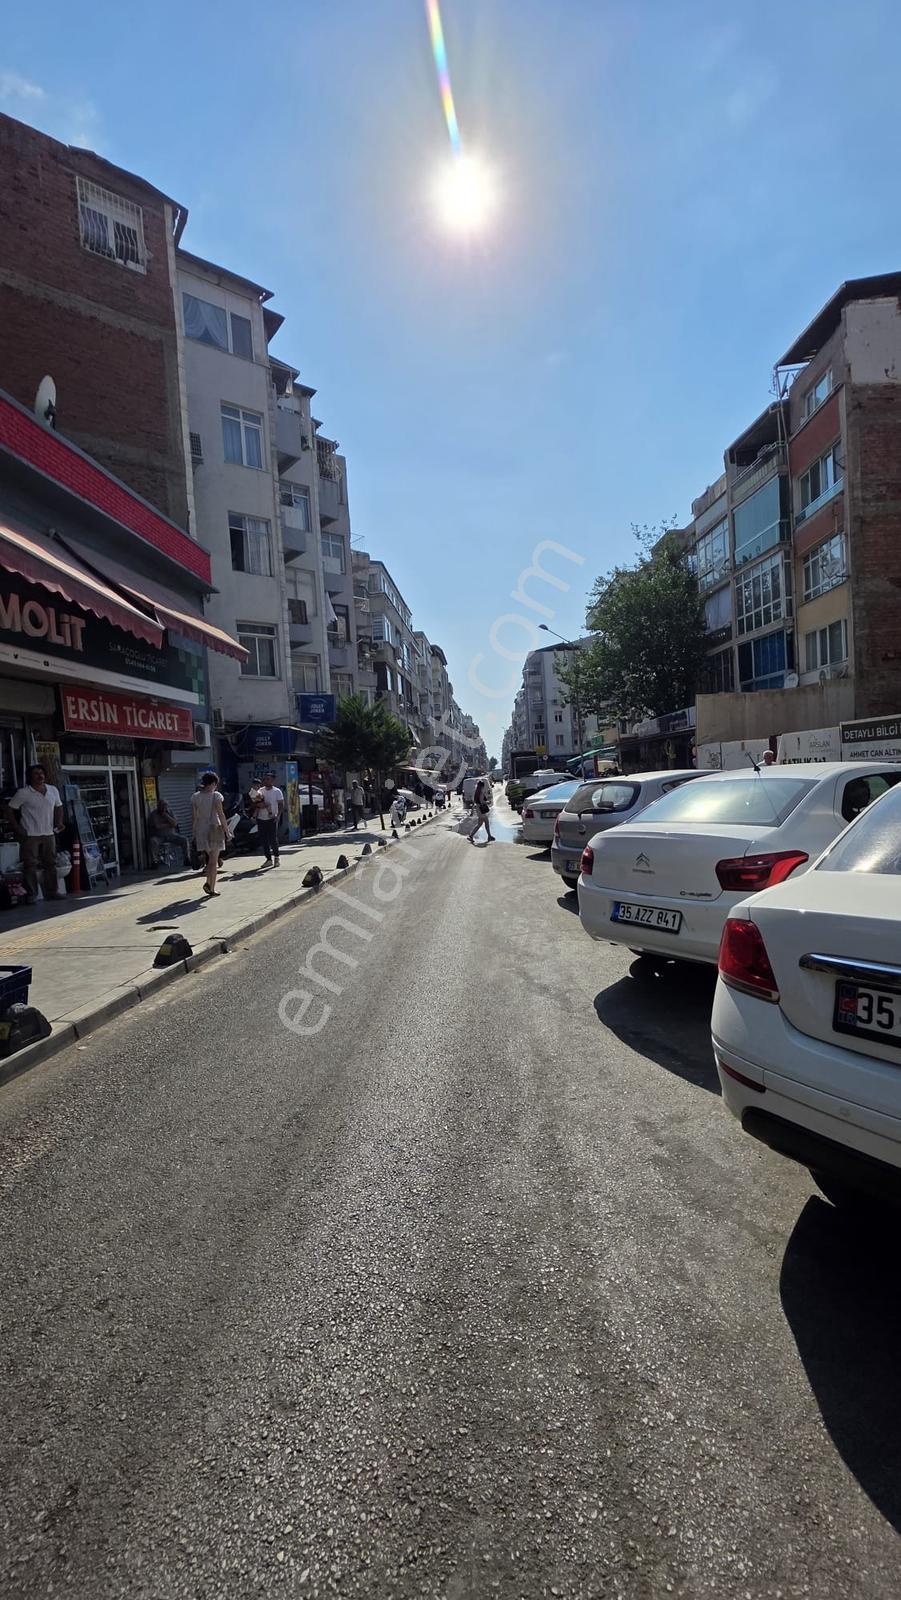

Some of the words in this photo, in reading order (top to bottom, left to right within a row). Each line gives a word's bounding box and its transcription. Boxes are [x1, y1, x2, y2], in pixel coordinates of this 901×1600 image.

[66, 696, 119, 725] ERSİN
[123, 702, 180, 732] TİCARET
[843, 728, 875, 740] DETAYLI
[876, 722, 898, 737] BİLGİ
[870, 749, 884, 757] CAN
[619, 905, 632, 919] 35
[635, 908, 655, 923] AZZ
[656, 911, 677, 928] 841
[857, 992, 895, 1030] 35
